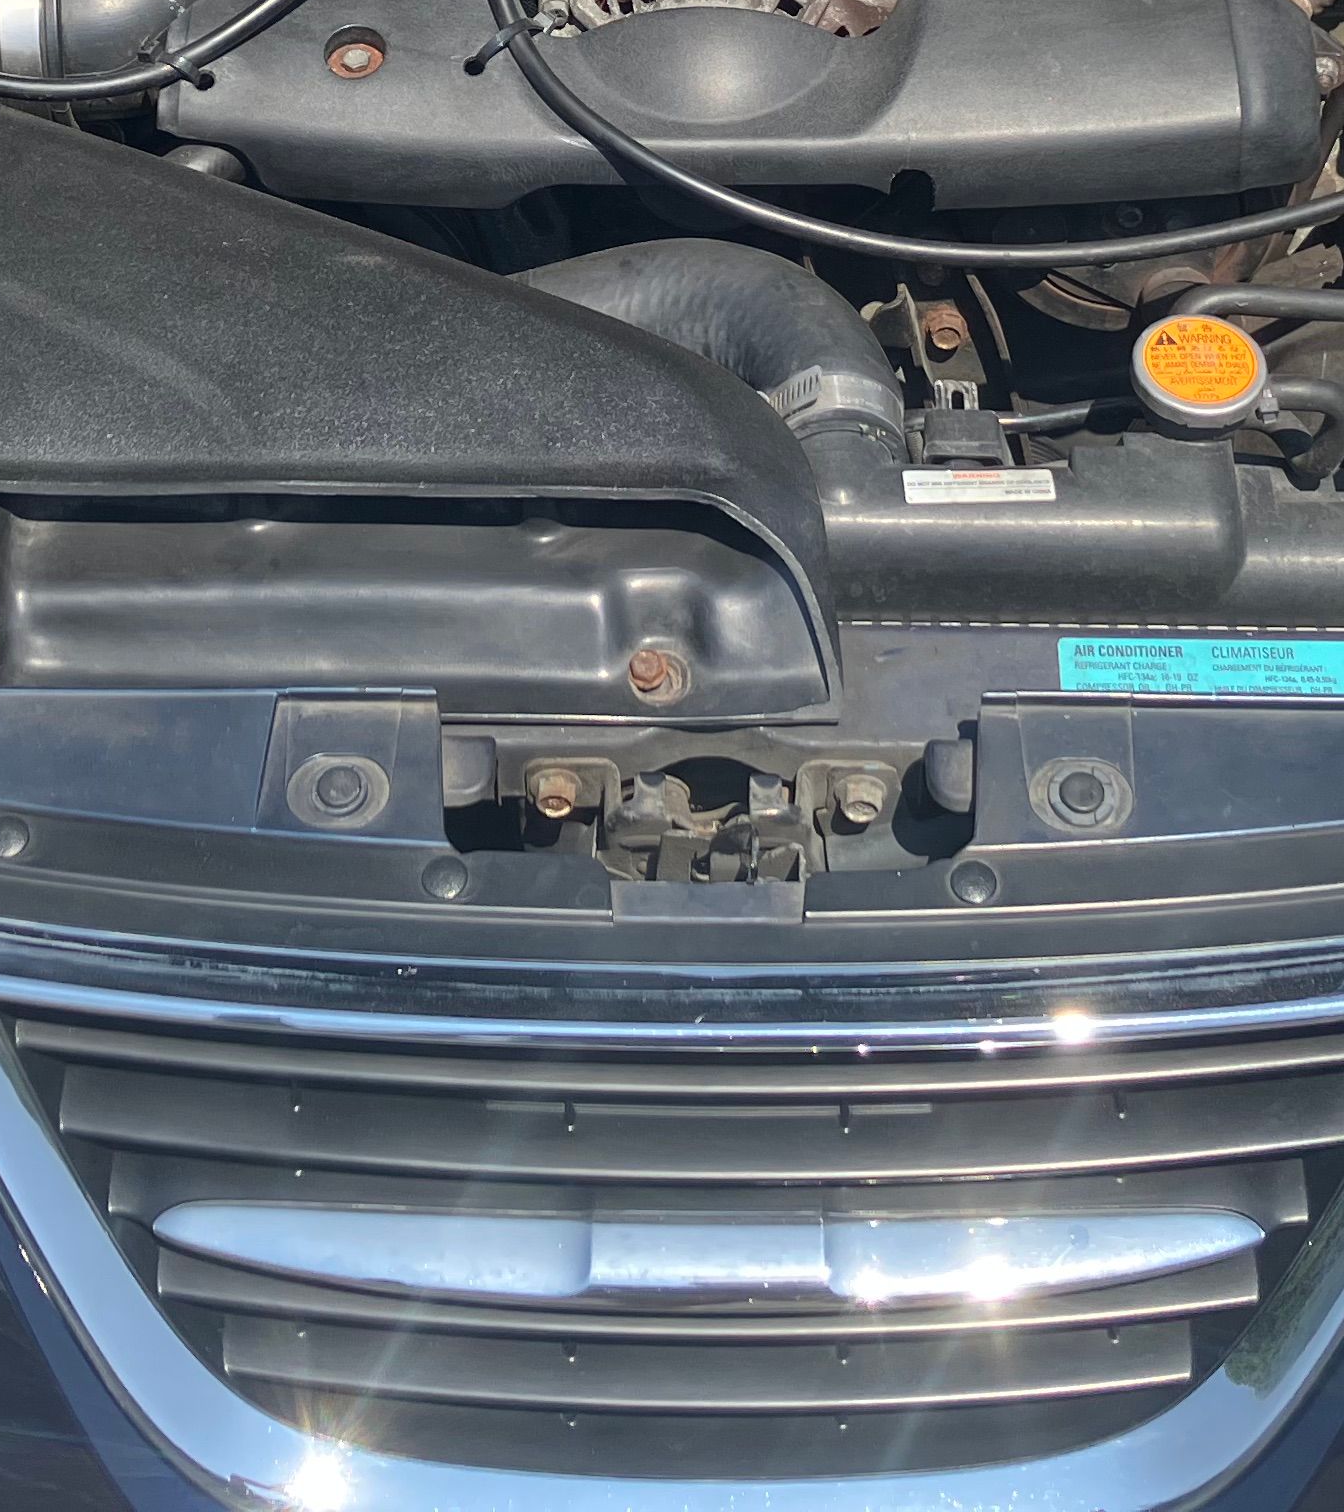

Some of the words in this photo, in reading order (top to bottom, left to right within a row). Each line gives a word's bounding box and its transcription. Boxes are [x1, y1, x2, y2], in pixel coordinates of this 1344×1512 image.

[1178, 333, 1232, 344] WARNING
[1074, 645, 1095, 657] AIR
[1098, 645, 1183, 658] CONDITIONER
[1211, 646, 1294, 659] CLIMATISEUR
[1074, 661, 1131, 670] REFRIGERANT
[1212, 664, 1261, 672] CHARGEMENT
